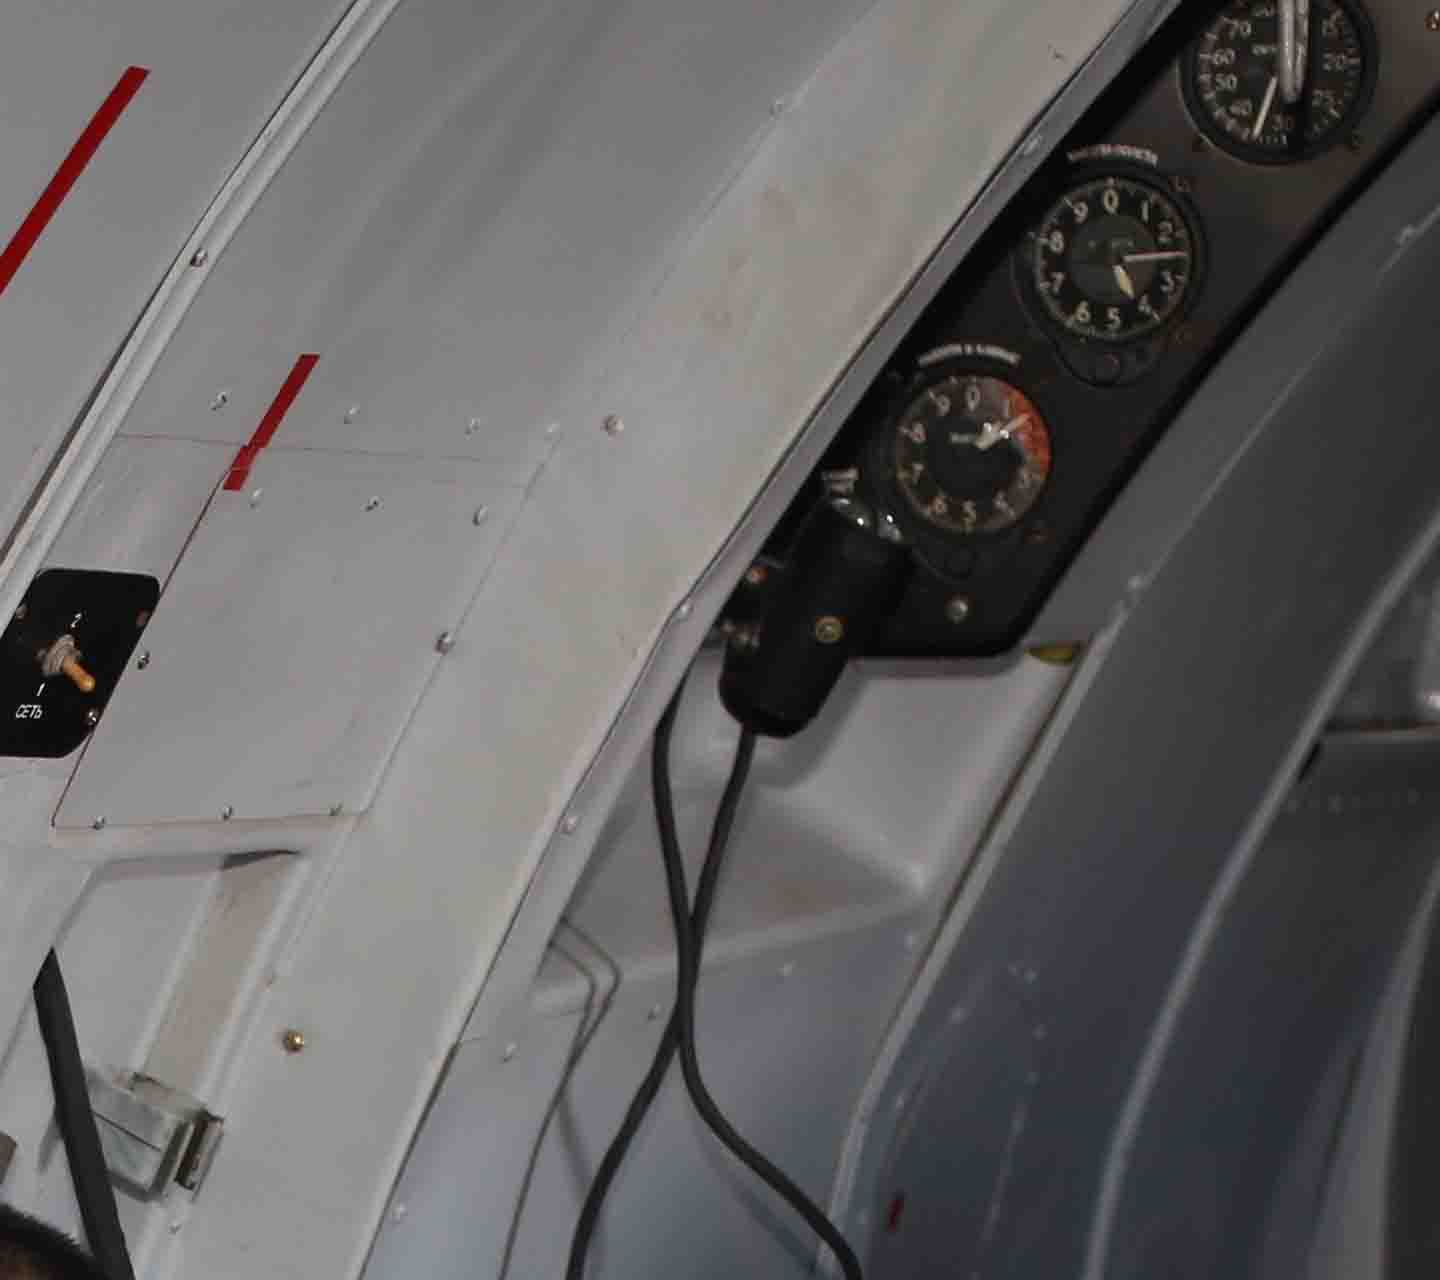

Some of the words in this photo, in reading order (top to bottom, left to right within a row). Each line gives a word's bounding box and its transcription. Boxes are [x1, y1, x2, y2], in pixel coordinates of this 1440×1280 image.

[1215, 74, 1238, 91] 50
[1072, 201, 1088, 224] 9
[1103, 189, 1119, 214] 0
[1141, 199, 1149, 222] 1
[1049, 230, 1064, 253] 8
[1157, 221, 1173, 244] 2
[1052, 271, 1064, 292] 7
[1076, 301, 1090, 322] 6
[1107, 306, 1120, 328] 5
[71, 612, 83, 629] 2
